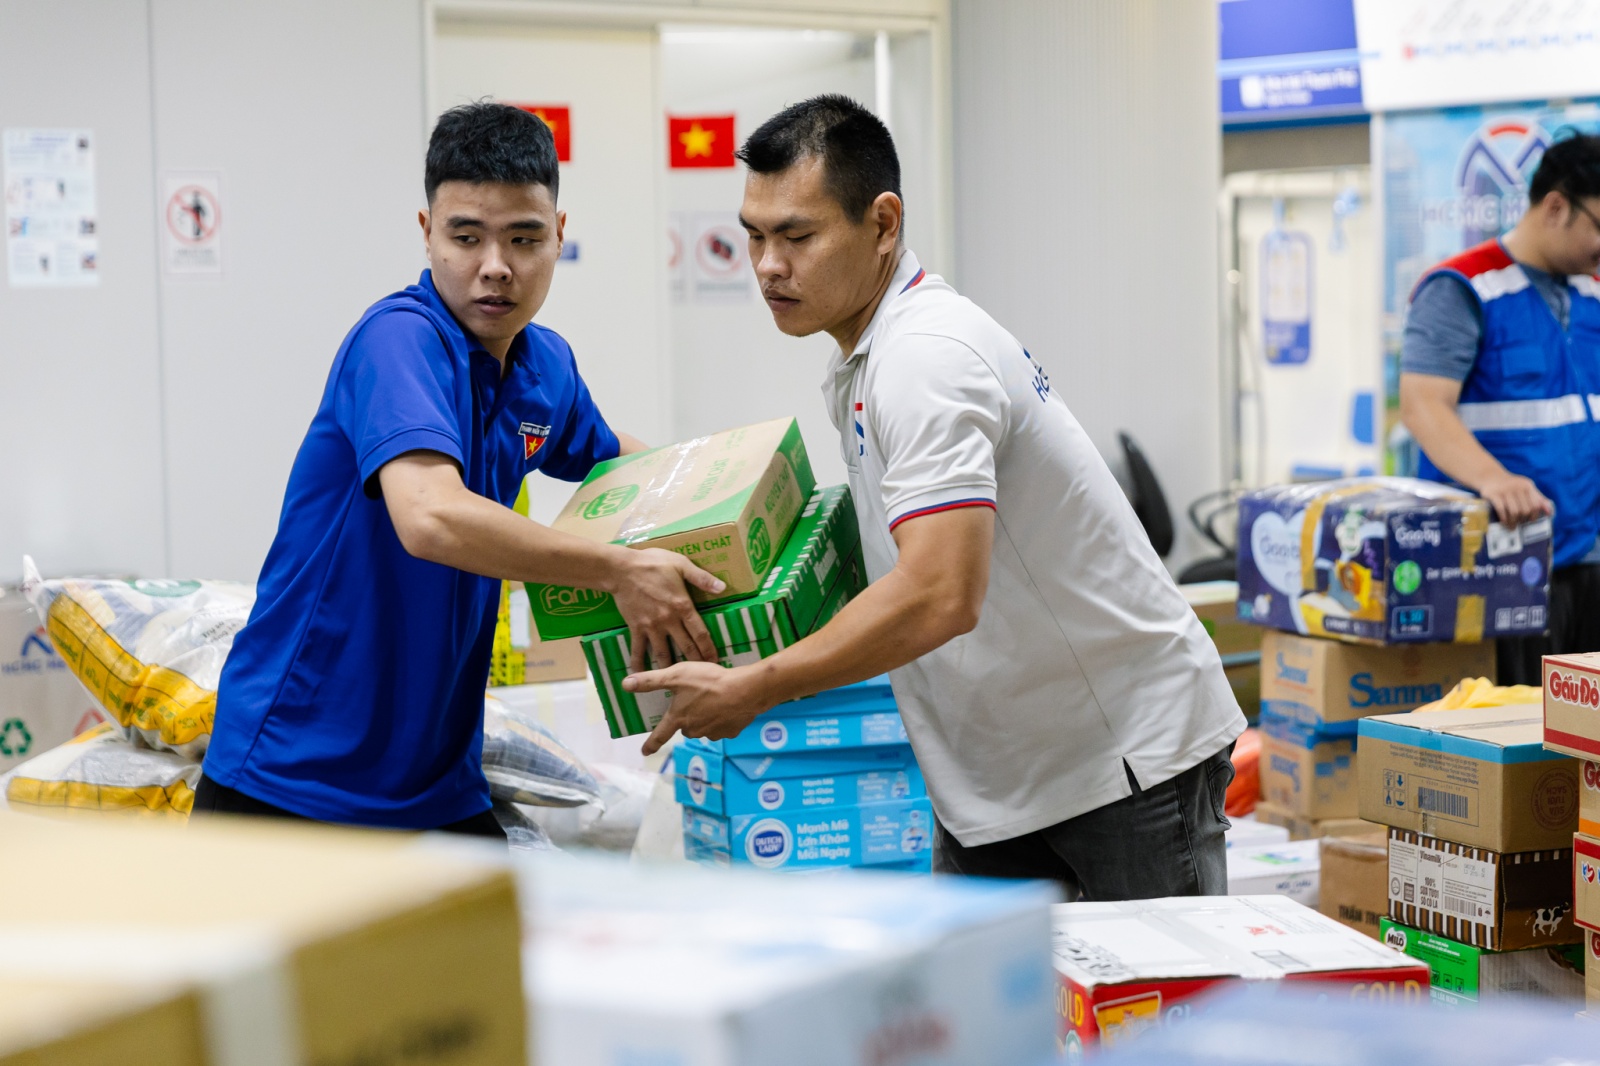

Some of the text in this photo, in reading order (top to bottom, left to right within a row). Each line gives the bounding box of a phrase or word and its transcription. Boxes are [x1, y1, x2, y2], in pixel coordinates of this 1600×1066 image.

[704, 533, 731, 551] CHẤT
[1349, 672, 1442, 708] Sanna
[1549, 671, 1600, 708] Gấu Đỏ
[796, 819, 849, 834] Mạnh Mẽ
[755, 835, 782, 846] DUTCH
[797, 832, 850, 848] Lớn Khôn
[758, 844, 779, 854] LADY
[797, 846, 851, 860] Mỗi Ngày
[1419, 850, 1442, 865] Vinamilk
[1424, 876, 1436, 888] 100%
[1387, 933, 1405, 947] MILO
